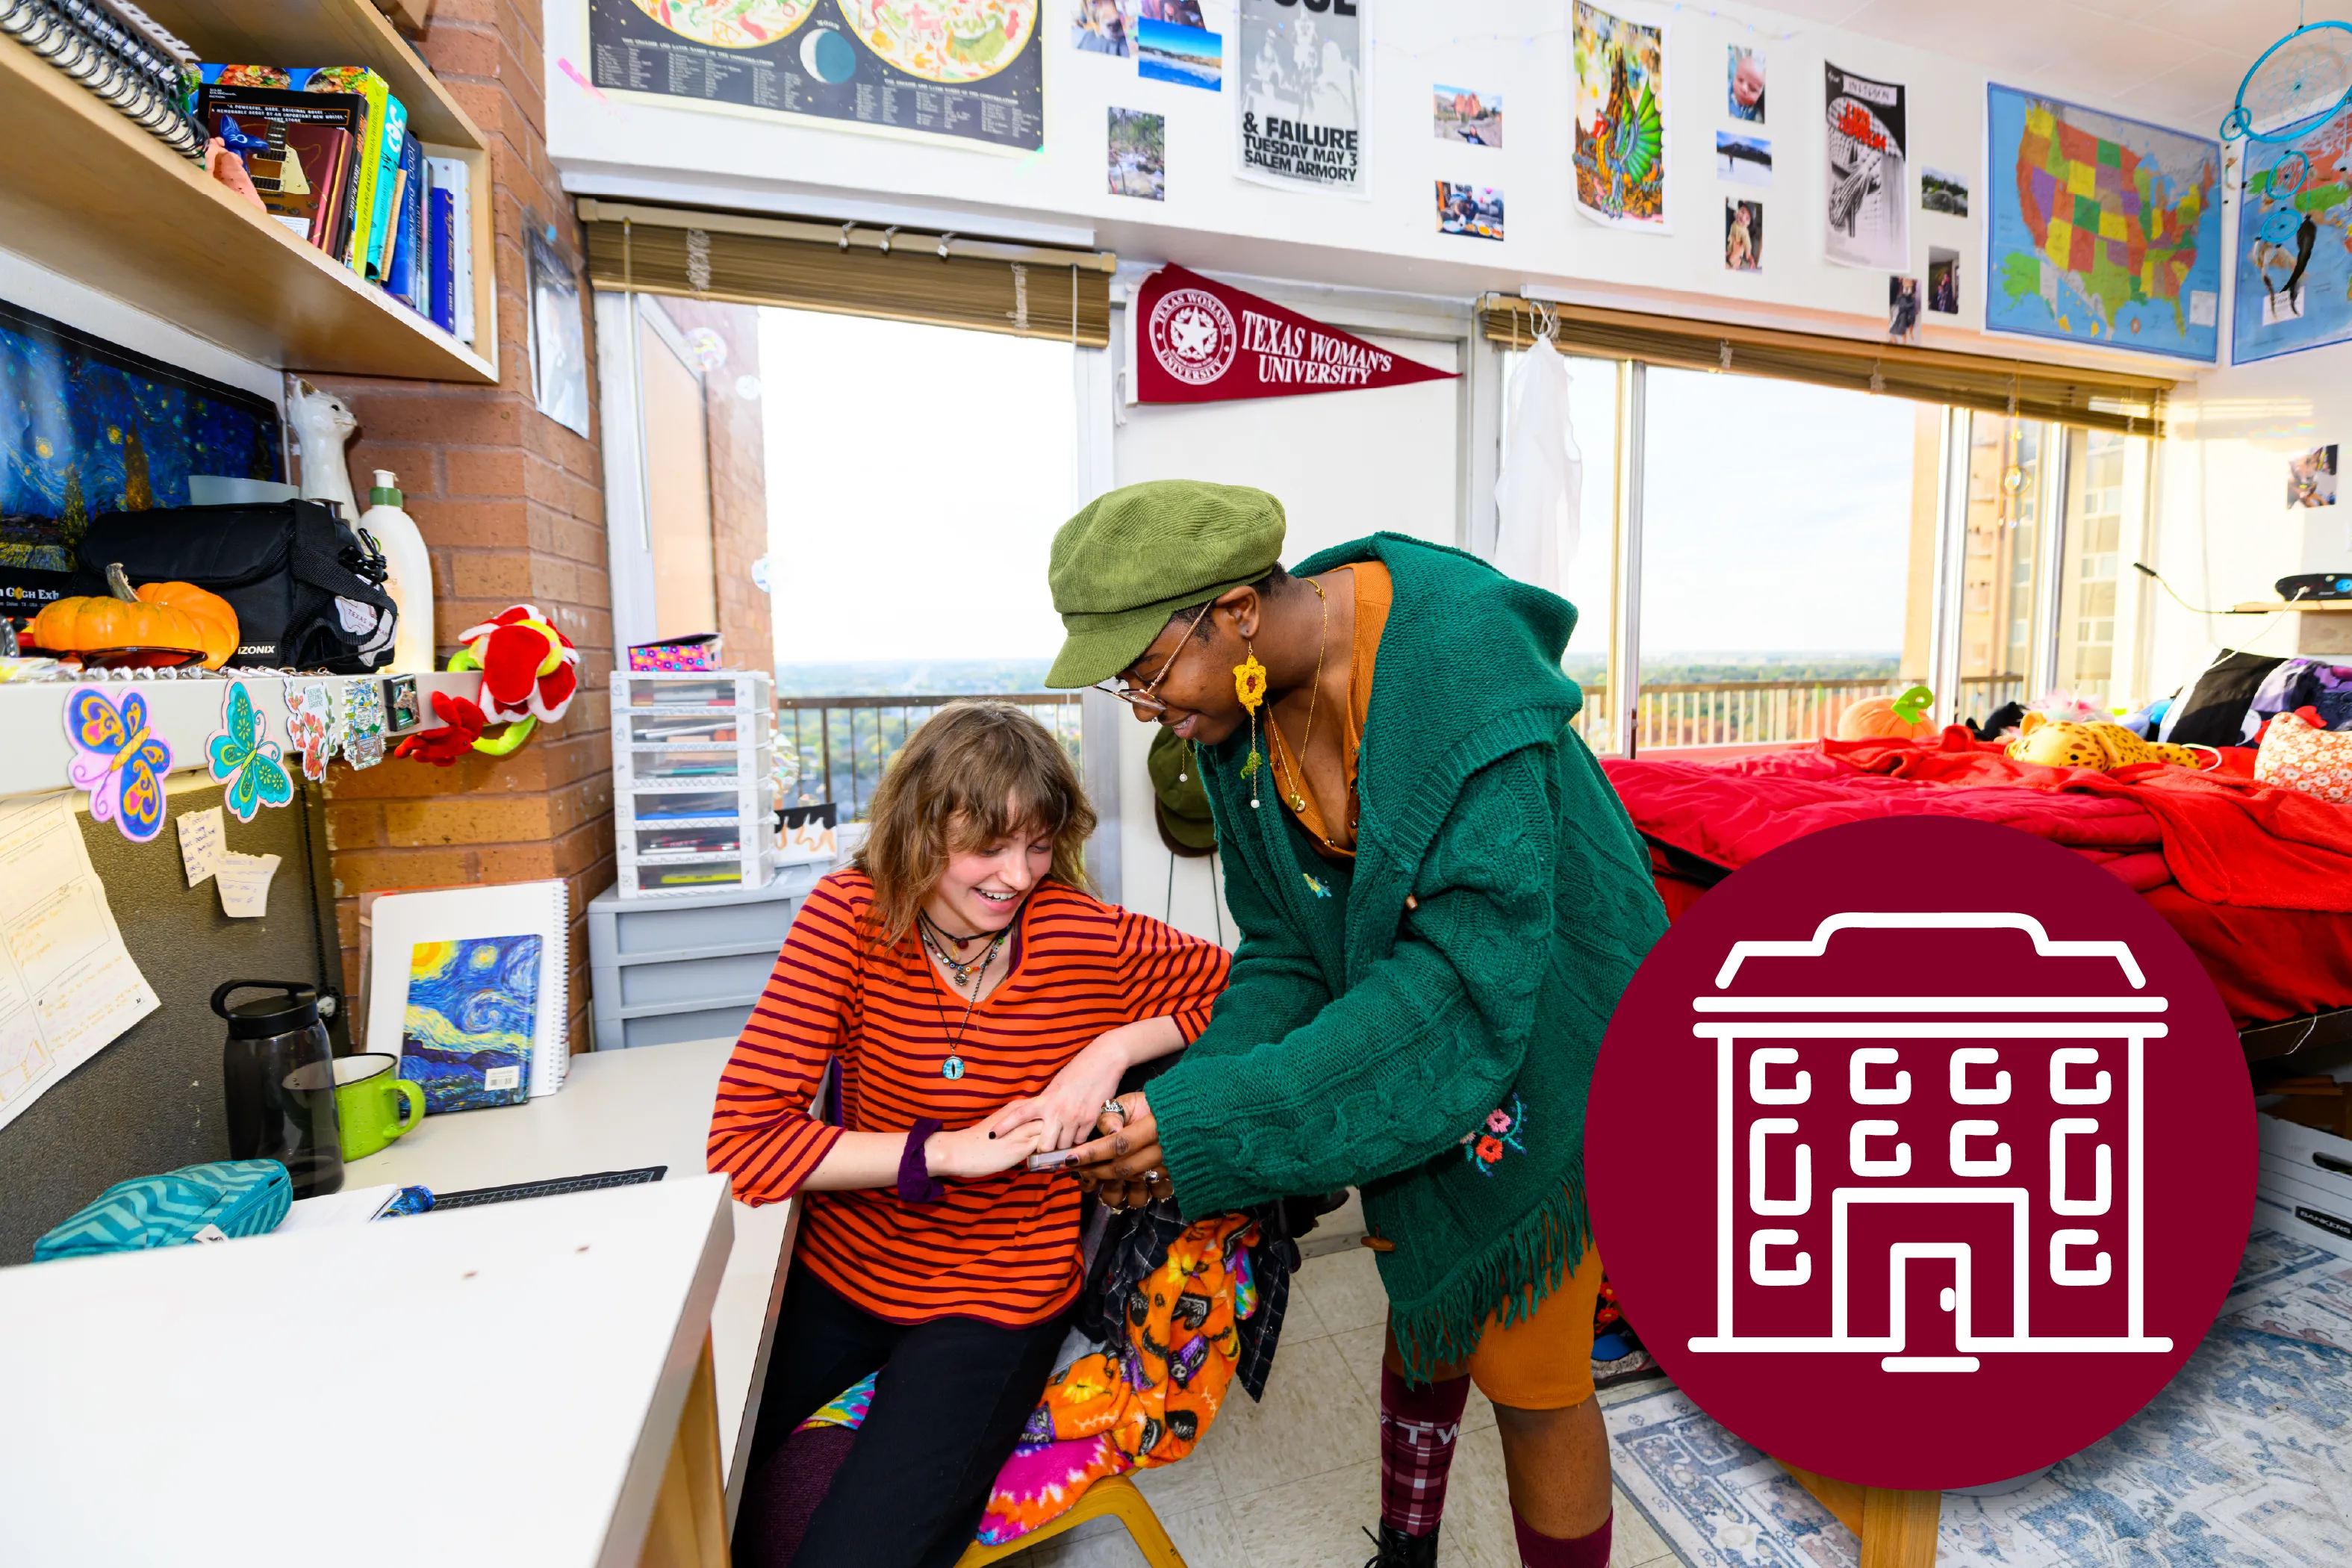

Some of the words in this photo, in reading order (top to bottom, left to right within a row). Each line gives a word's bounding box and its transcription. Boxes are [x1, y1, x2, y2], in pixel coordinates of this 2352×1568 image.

[1243, 111, 1259, 134] &
[1266, 116, 1357, 151] FAILURE
[1244, 134, 1307, 159] TUESDAY
[1313, 148, 1345, 166] MAY
[1349, 153, 1357, 167] 3
[1245, 150, 1292, 172] SALEM
[1295, 161, 1357, 181] ARMORY
[1155, 294, 1185, 323] TEXAS
[1186, 293, 1231, 335] WOMAN'S
[1241, 310, 1306, 357] TEXAS
[1310, 332, 1393, 373] WOMAN'S
[1160, 348, 1223, 379] UNIVERSITY
[1259, 353, 1372, 385] UNIVERSITY
[348, 609, 367, 623] TEXAS
[237, 645, 276, 655] iZONIX
[2300, 1210, 2351, 1234] BANKERS
